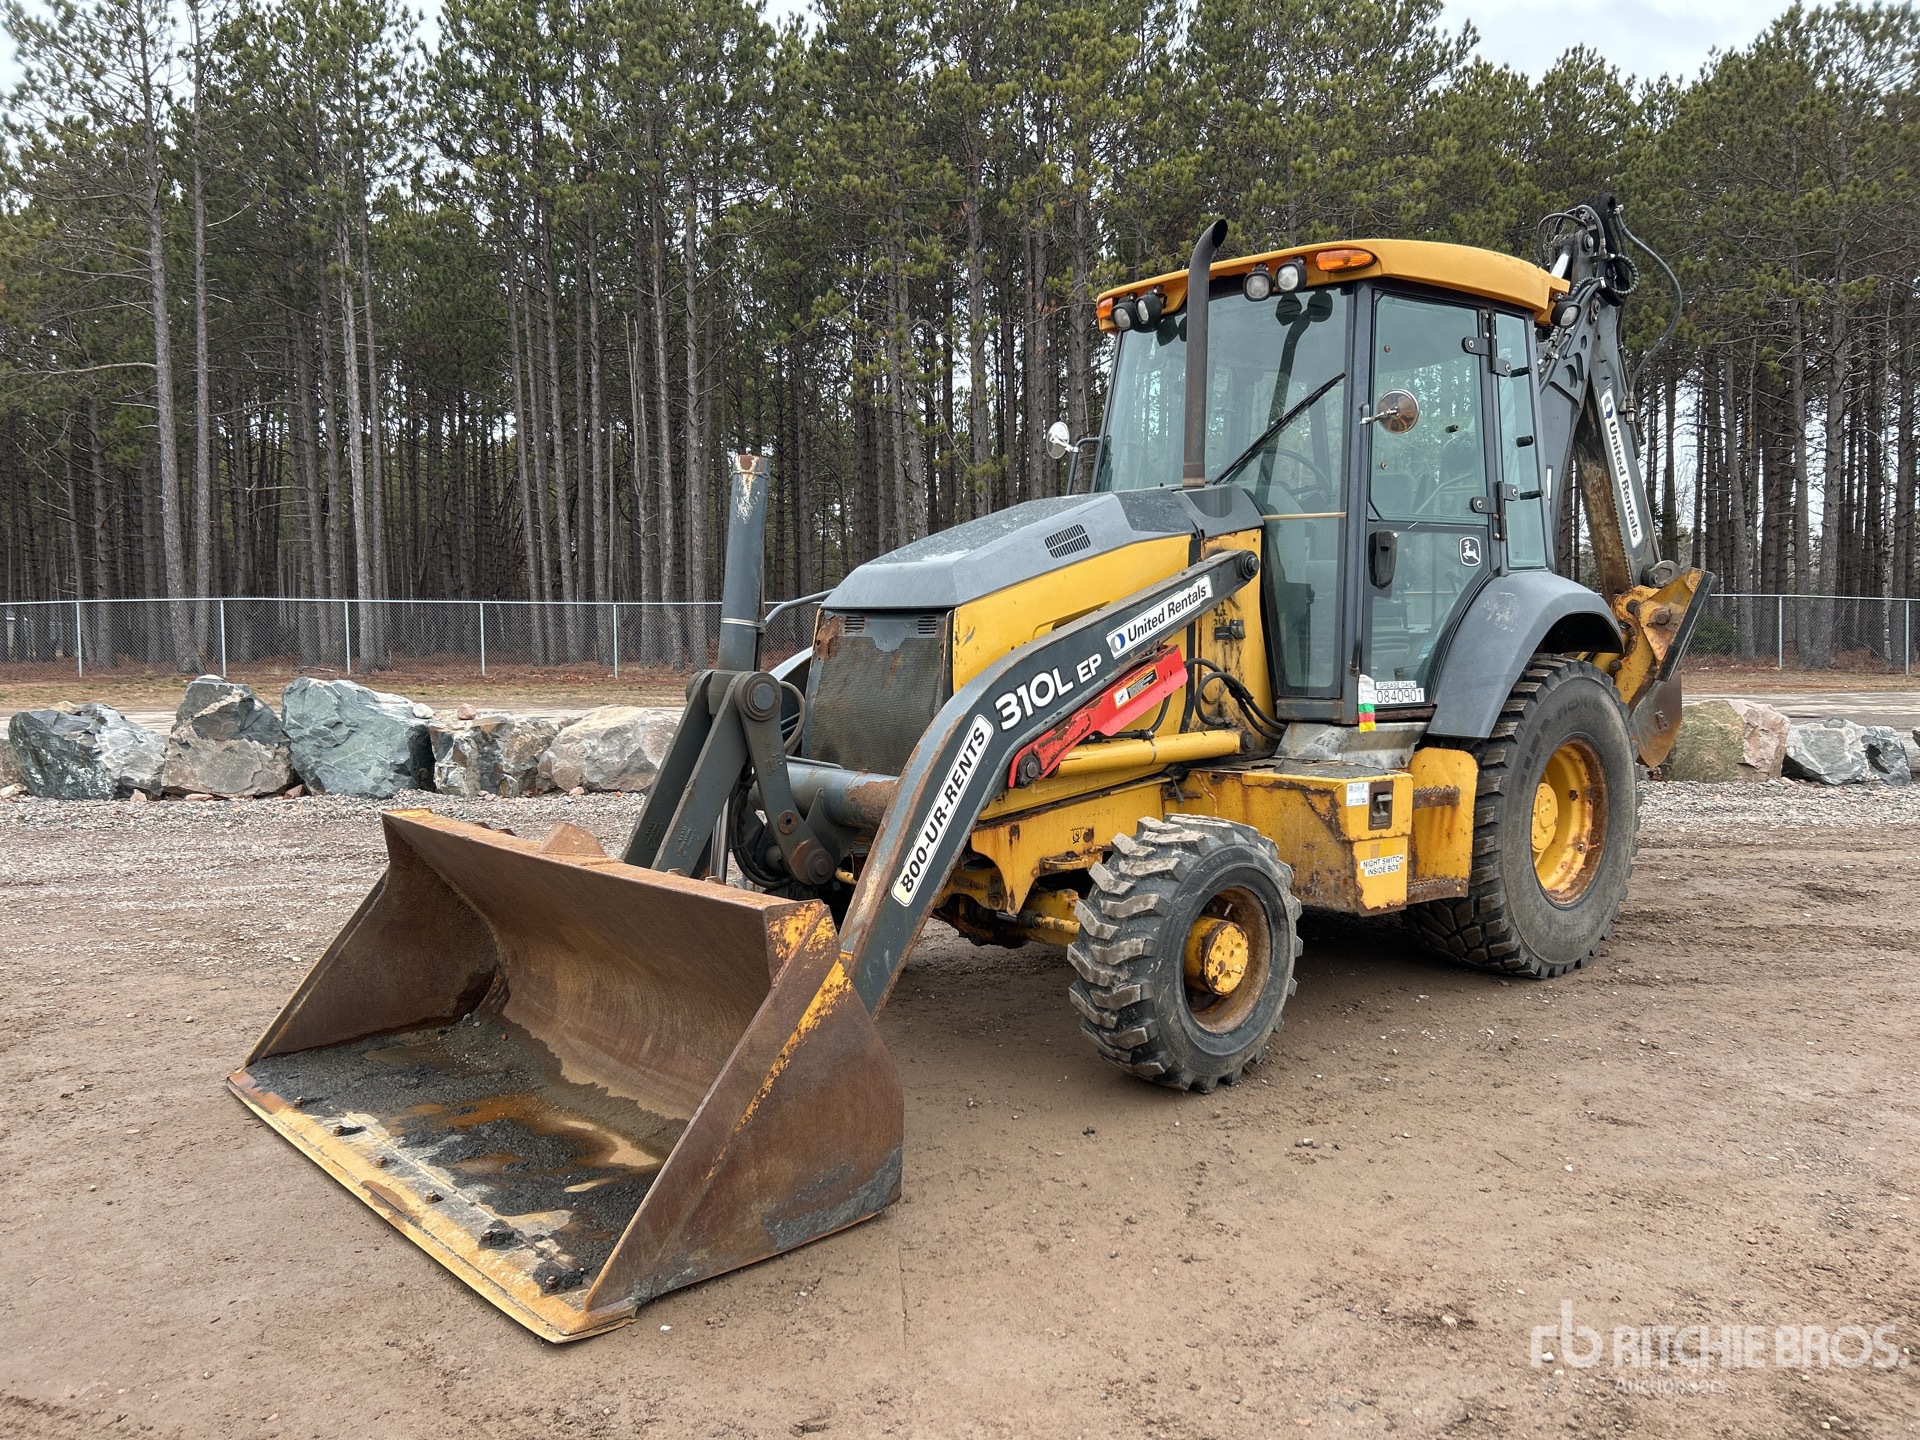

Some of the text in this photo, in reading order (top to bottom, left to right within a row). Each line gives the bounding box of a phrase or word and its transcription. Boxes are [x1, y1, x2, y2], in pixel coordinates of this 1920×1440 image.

[1609, 421, 1639, 538] United Rentals
[1127, 584, 1208, 643] United Rentals
[994, 666, 1074, 731] 310L
[1075, 653, 1102, 685] EP
[1377, 689, 1422, 703] 0840901
[900, 725, 986, 895] 800-UR-RENTS
[1363, 855, 1404, 867] NIGHT SWITCH
[1367, 864, 1399, 875] INSIDE BOX
